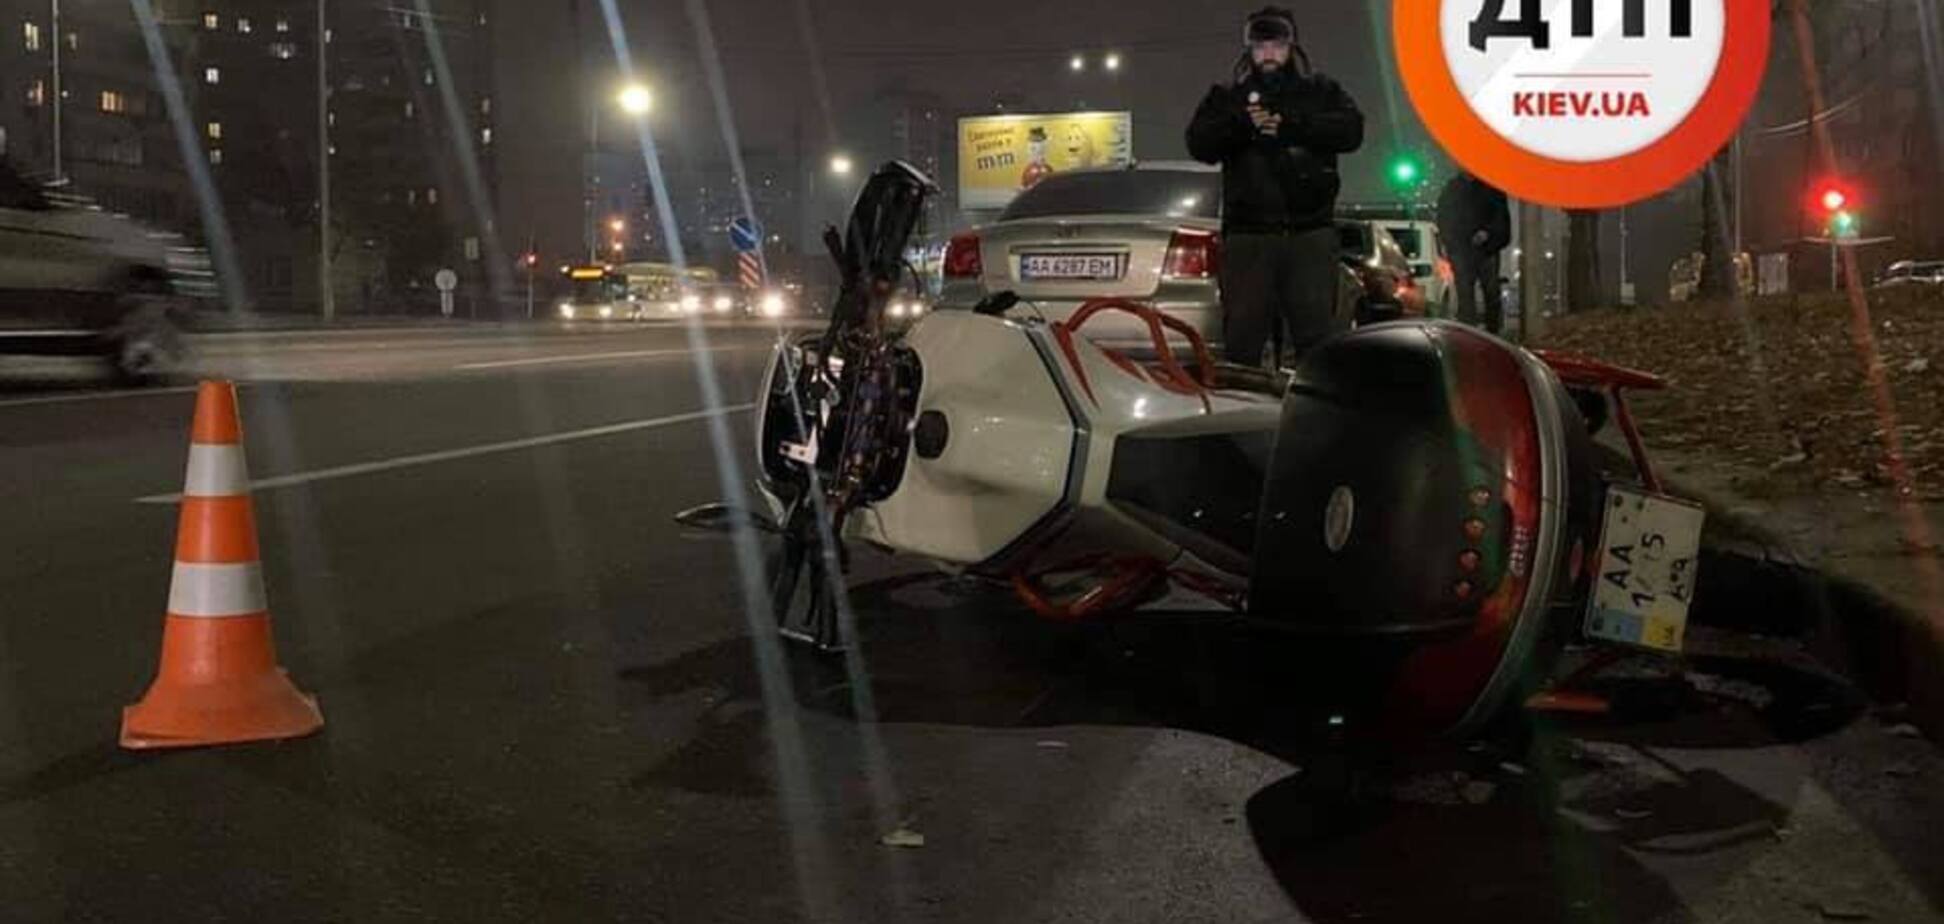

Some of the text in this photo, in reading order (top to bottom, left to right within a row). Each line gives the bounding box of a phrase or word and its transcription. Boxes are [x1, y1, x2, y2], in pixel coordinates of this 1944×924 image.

[1031, 259, 1050, 271] AA
[1603, 544, 1634, 590] AA
[1631, 532, 1665, 608] 15
